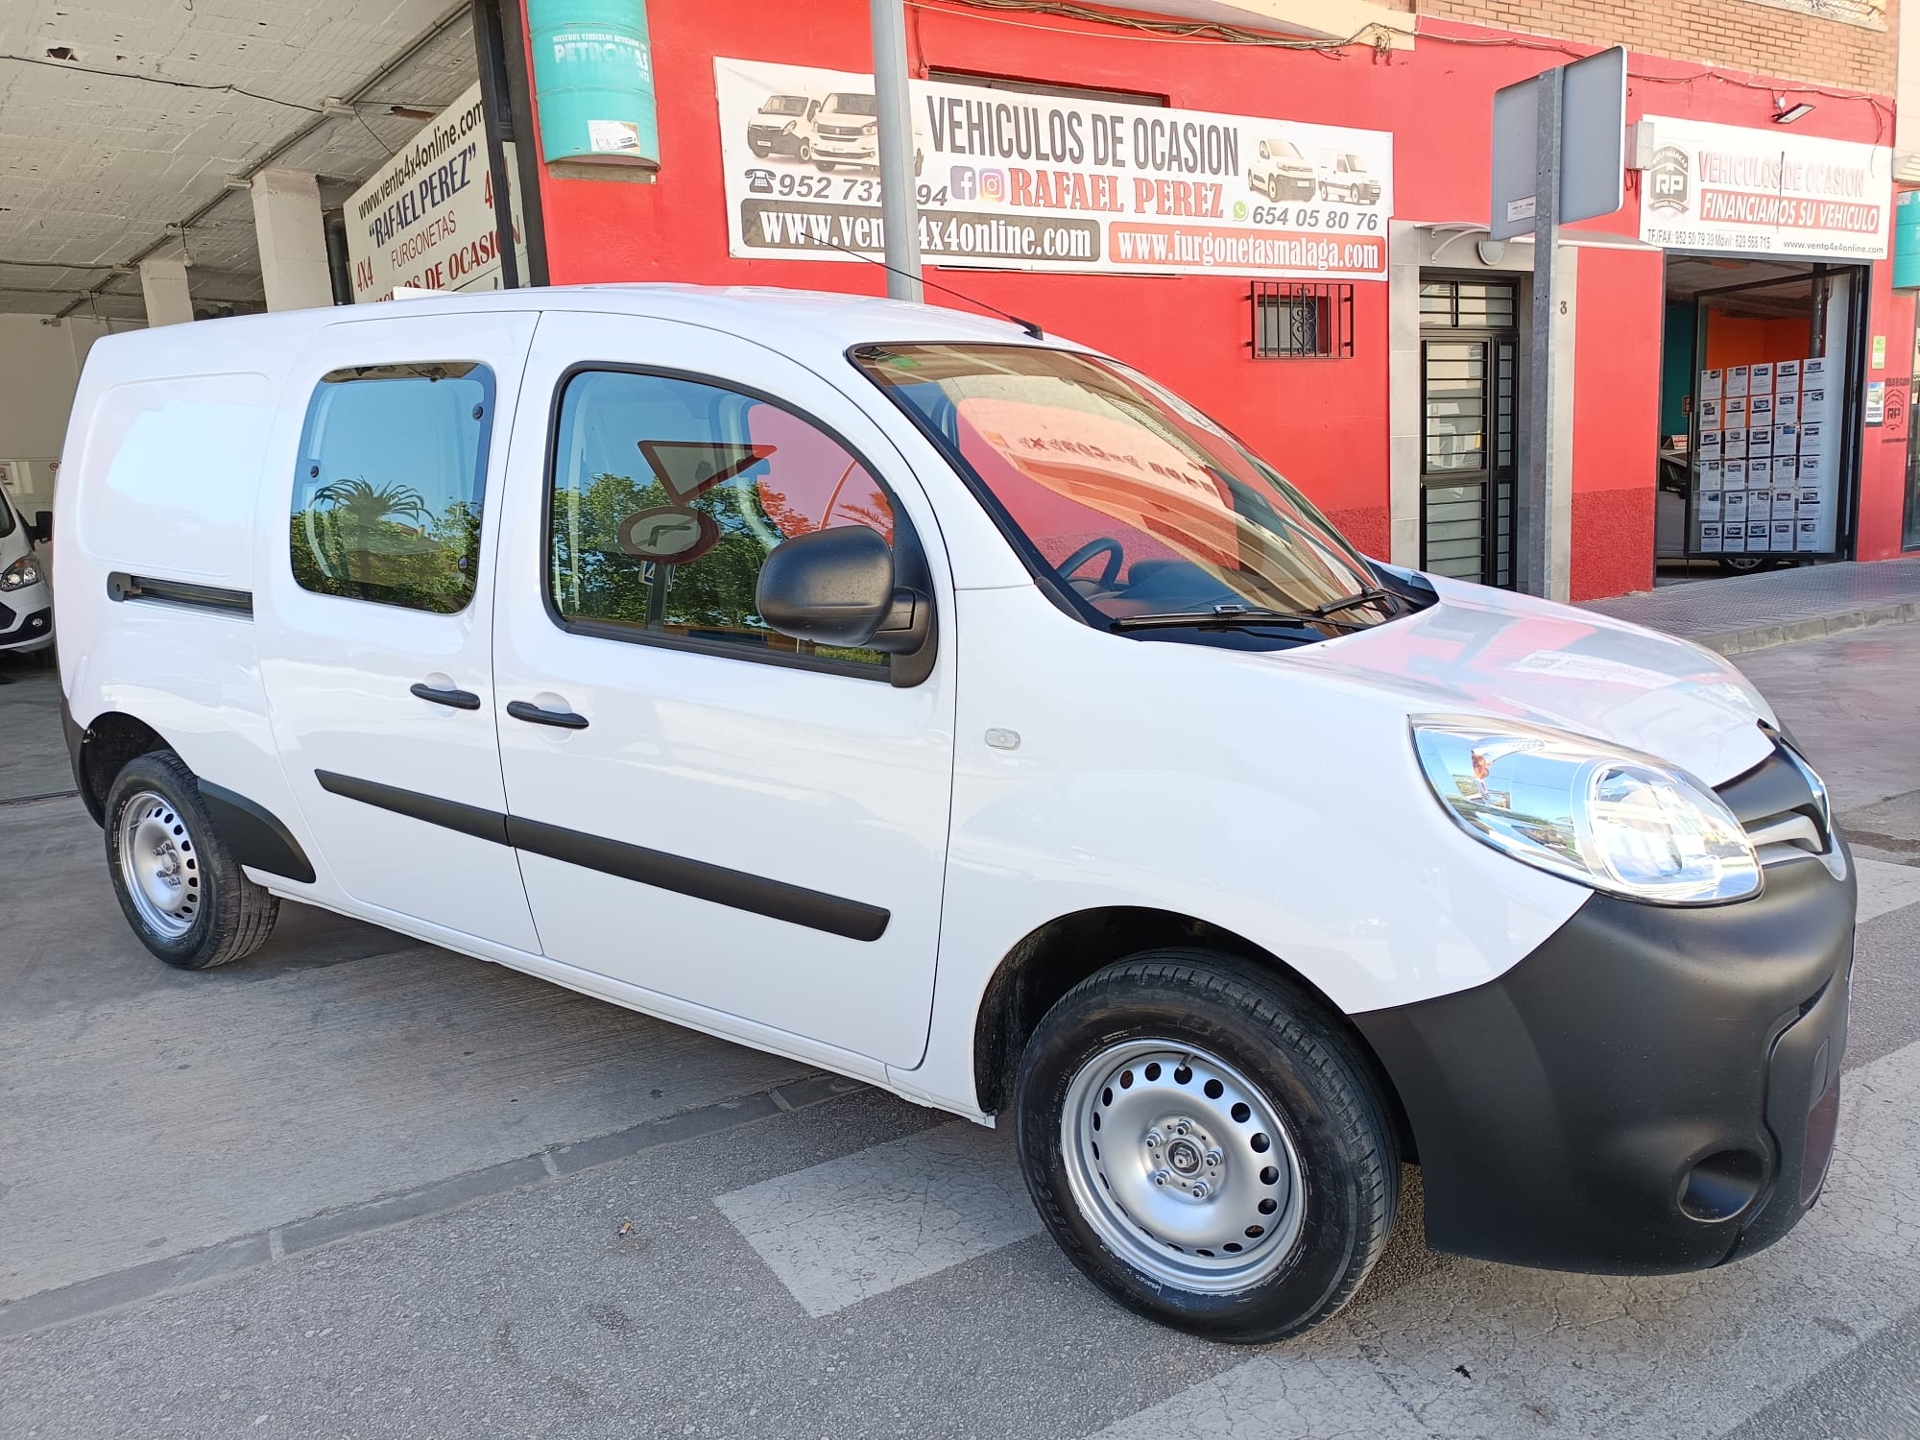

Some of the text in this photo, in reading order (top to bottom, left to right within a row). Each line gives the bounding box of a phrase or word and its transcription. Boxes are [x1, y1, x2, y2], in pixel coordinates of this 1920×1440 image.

[553, 41, 649, 72] PETRONAS
[926, 95, 1240, 177] VEHICULOS DE OCASION
[358, 100, 484, 221] www.venta4x4online.com
[1698, 150, 1865, 197] VEHICULOS DE OCASION
[777, 173, 832, 199] 952
[916, 184, 949, 206] 94
[1008, 167, 1224, 219] RAFAEL PEREZ
[1655, 174, 1684, 195] RP
[1252, 205, 1379, 231] 654 05 80 76
[1702, 192, 1878, 231] FINANCIAMOS SU VEHICULO
[391, 210, 457, 271] FURGONETAS
[759, 210, 1091, 258] www.ven4x4online.com
[1117, 230, 1379, 270] www.furgonetasmalaga.com
[1675, 230, 1686, 244] 952
[1688, 231, 1696, 246] 50
[1697, 232, 1706, 246] 79
[1760, 236, 1771, 250] 715
[1783, 241, 1883, 254] www.venta4x4online.com
[357, 256, 374, 292] 4X4
[425, 261, 446, 290] DE
